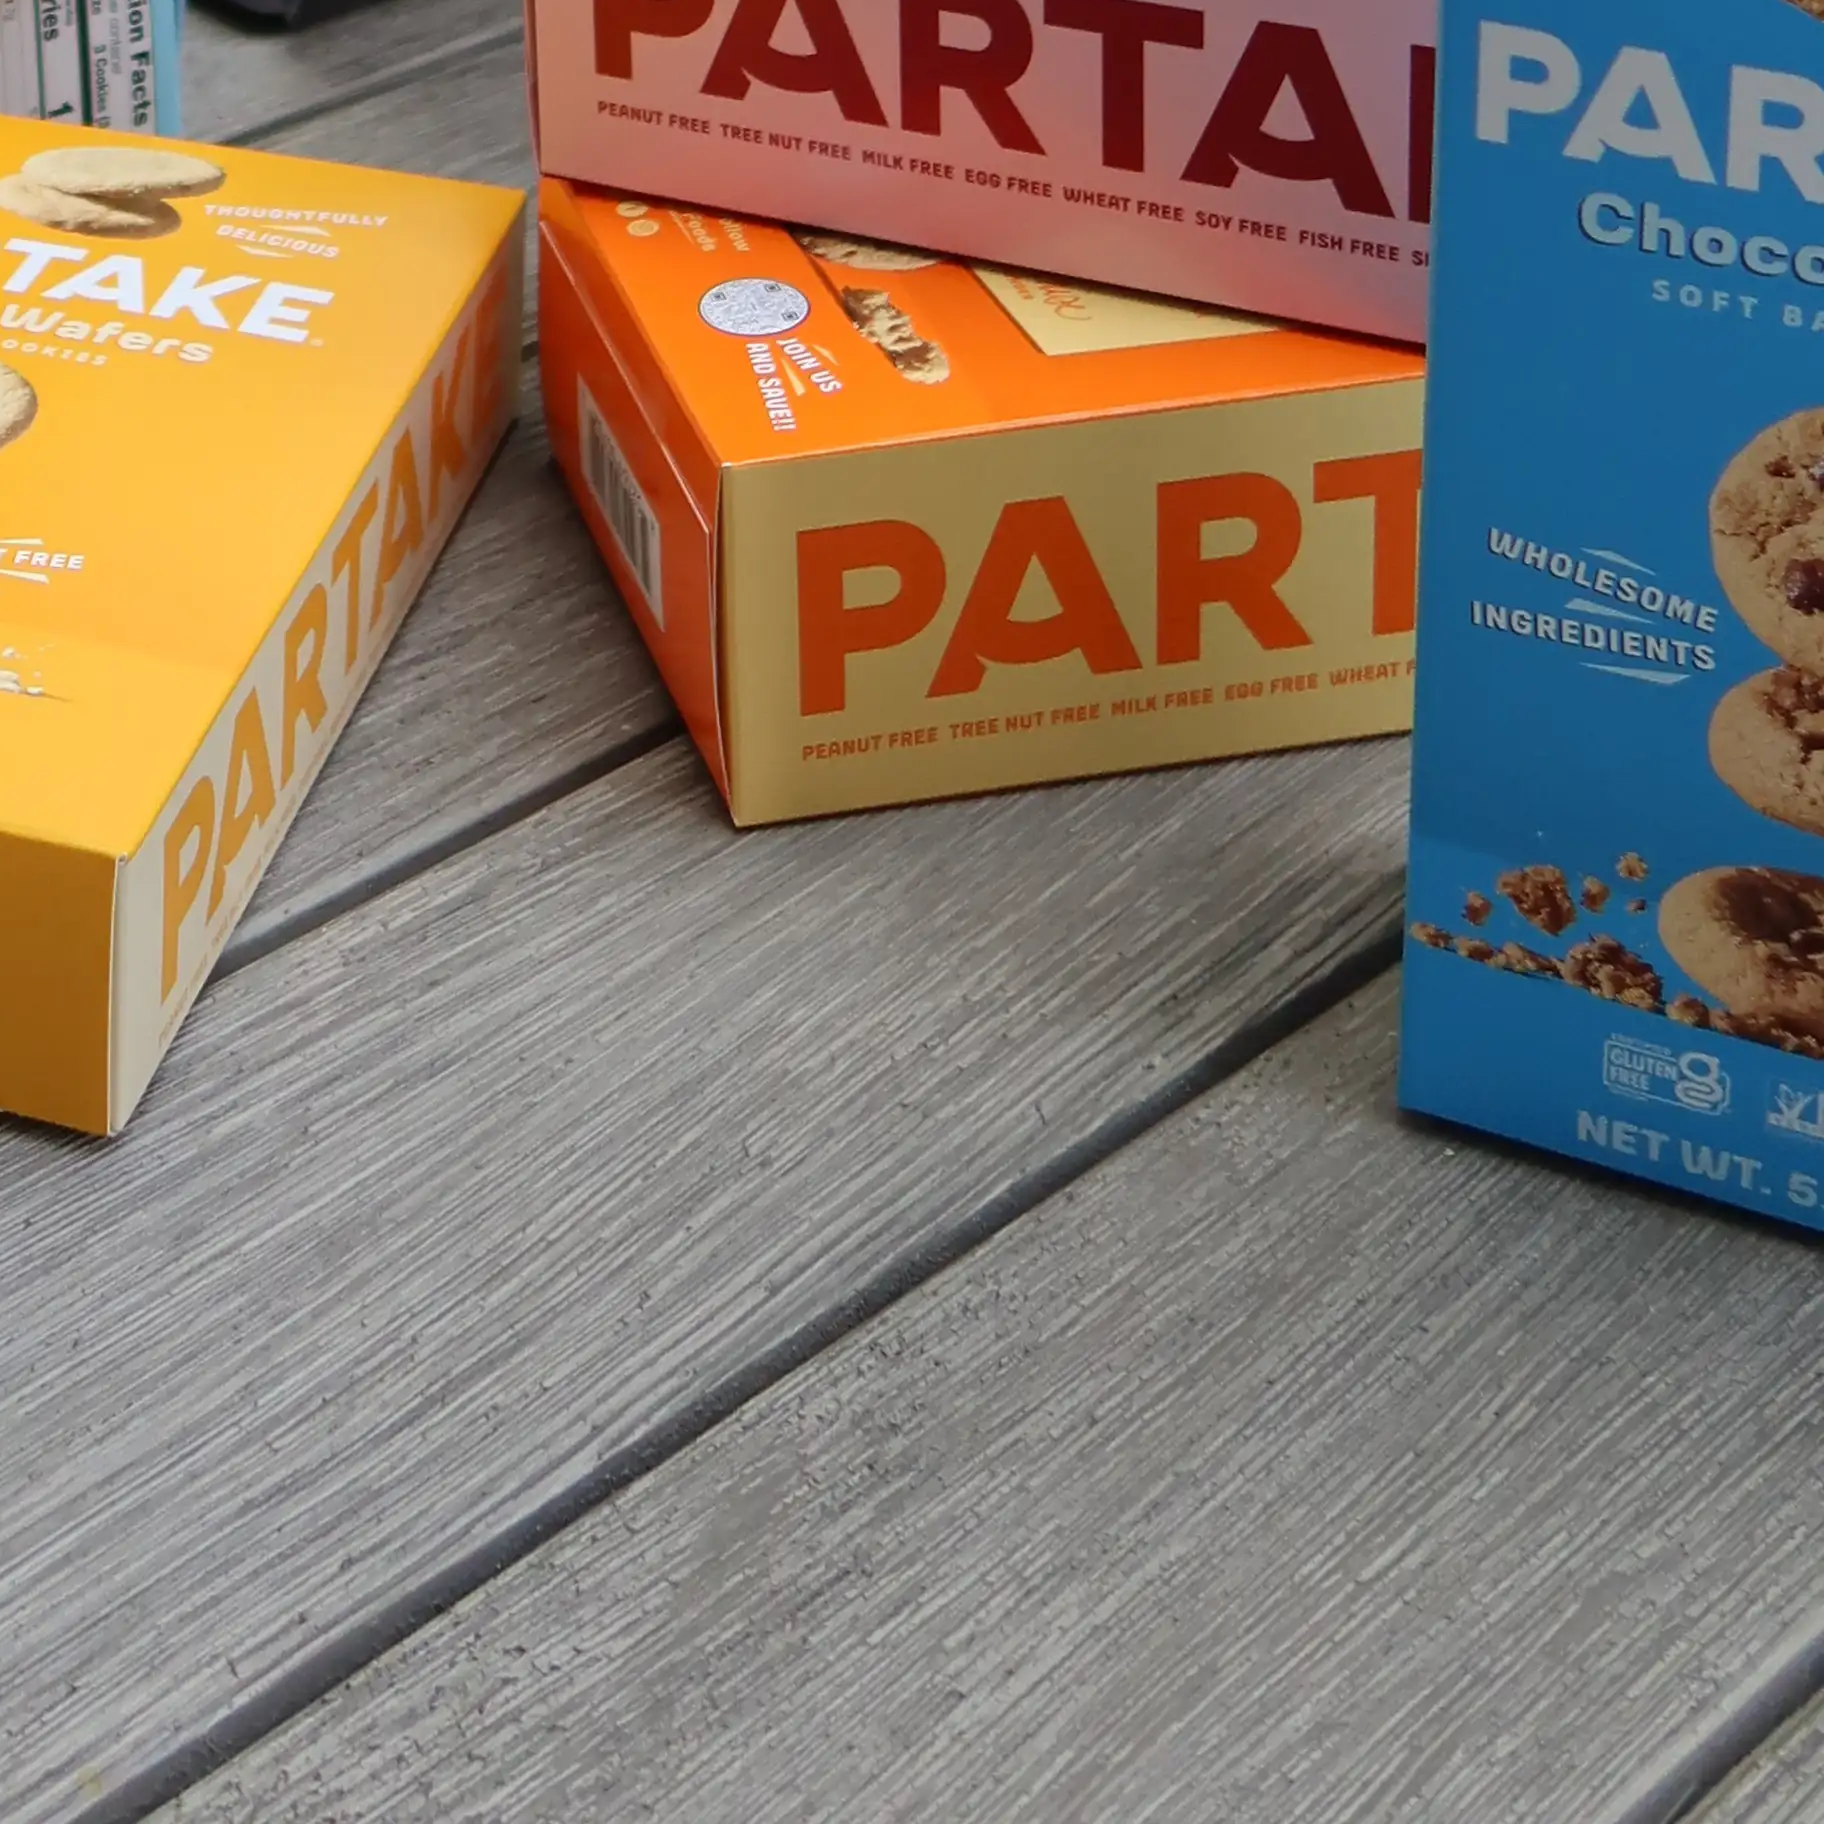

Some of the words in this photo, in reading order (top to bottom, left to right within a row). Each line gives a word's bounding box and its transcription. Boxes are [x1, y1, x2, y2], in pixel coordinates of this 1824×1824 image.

[95, 57, 110, 114] Cookies
[129, 51, 152, 128] Facts
[597, 100, 663, 127] PEANUT
[669, 113, 711, 135] FREE
[721, 122, 763, 145] TREE
[769, 133, 802, 152] NUT
[809, 140, 852, 161] FREE
[862, 150, 904, 171] MILK
[910, 158, 955, 181] FREE
[964, 167, 1002, 190] EGG
[1007, 175, 1053, 199] FREE
[1063, 186, 1132, 214] WHEAT
[1137, 199, 1185, 223] FREE
[1195, 209, 1233, 232] SOY
[1239, 218, 1287, 241] FREE
[1299, 228, 1343, 253] FISH
[1350, 238, 1400, 263] FREE
[204, 203, 390, 228] THOUGHTFULLY
[215, 224, 341, 259] DELICIOUS
[1651, 278, 1759, 320] SOFT
[746, 342, 777, 376] AND
[776, 338, 821, 371] JOIN
[810, 371, 844, 394] US
[758, 378, 798, 432] SAVE!!
[13, 549, 86, 571] FREE
[796, 448, 1422, 717] PART
[1487, 526, 1720, 633] WHOLESOME
[160, 237, 510, 1008] PARTAKE
[1470, 599, 1717, 671] INGREDIENTS
[801, 735, 883, 762] PEANUT
[888, 727, 939, 749] FREE
[948, 718, 1000, 740] TREE
[1005, 712, 1044, 733] NUT
[1050, 703, 1101, 725] FREE
[1111, 693, 1158, 717] MILK
[1164, 687, 1215, 709] FREE
[1224, 681, 1264, 702] EGG
[1270, 673, 1319, 694] FREE
[1329, 662, 1401, 687] WHEAT
[1608, 1048, 1678, 1081] GLUTEN
[1608, 1065, 1651, 1091] FREE
[1577, 1109, 1671, 1162] NET
[1680, 1139, 1772, 1196] WT.
